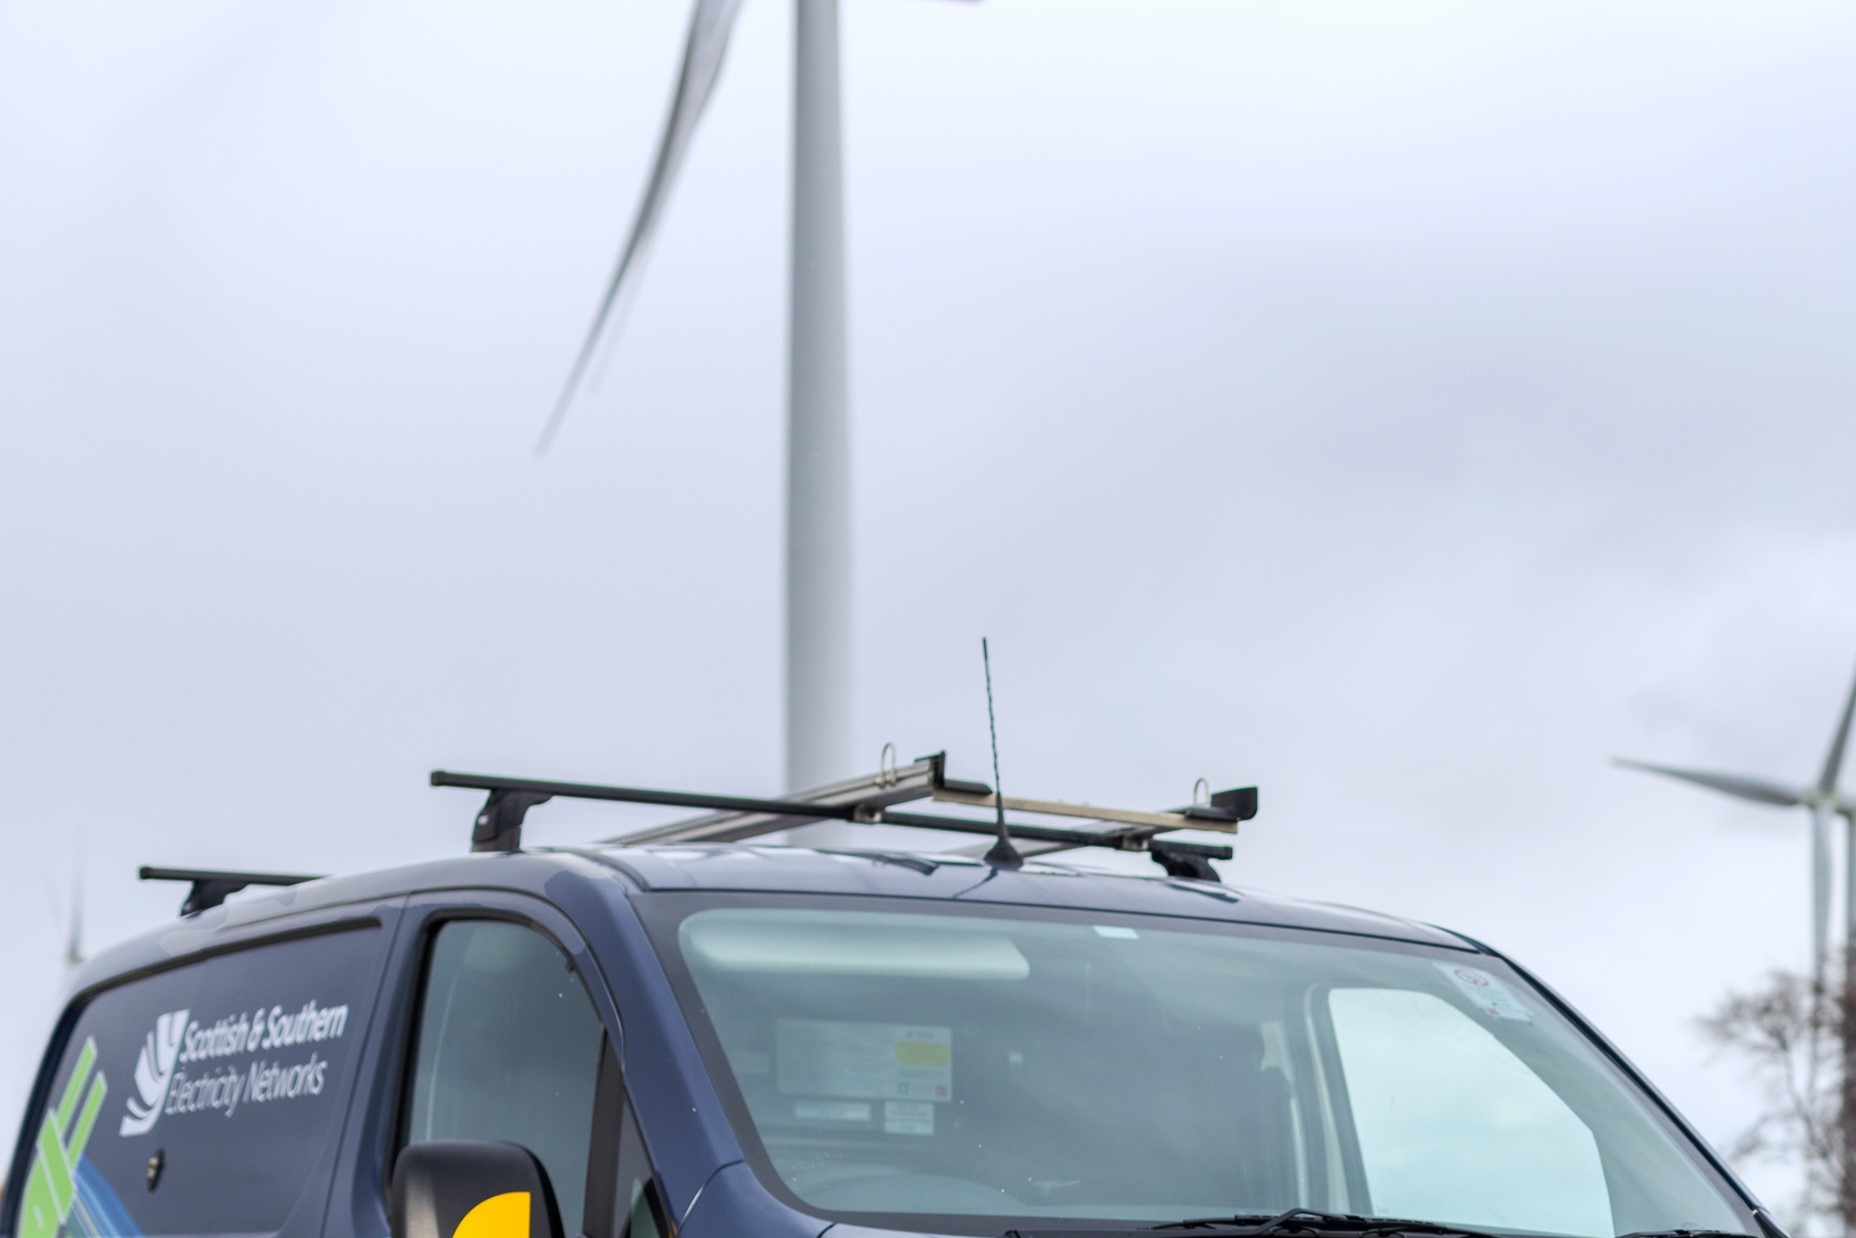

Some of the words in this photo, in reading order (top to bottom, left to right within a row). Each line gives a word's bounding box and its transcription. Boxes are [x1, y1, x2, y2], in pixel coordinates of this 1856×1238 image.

[179, 1019, 251, 1063] Scottish
[246, 1006, 267, 1052] &
[261, 999, 349, 1050] Southern
[164, 1064, 243, 1118] Electricity
[242, 1051, 328, 1105] Networks
